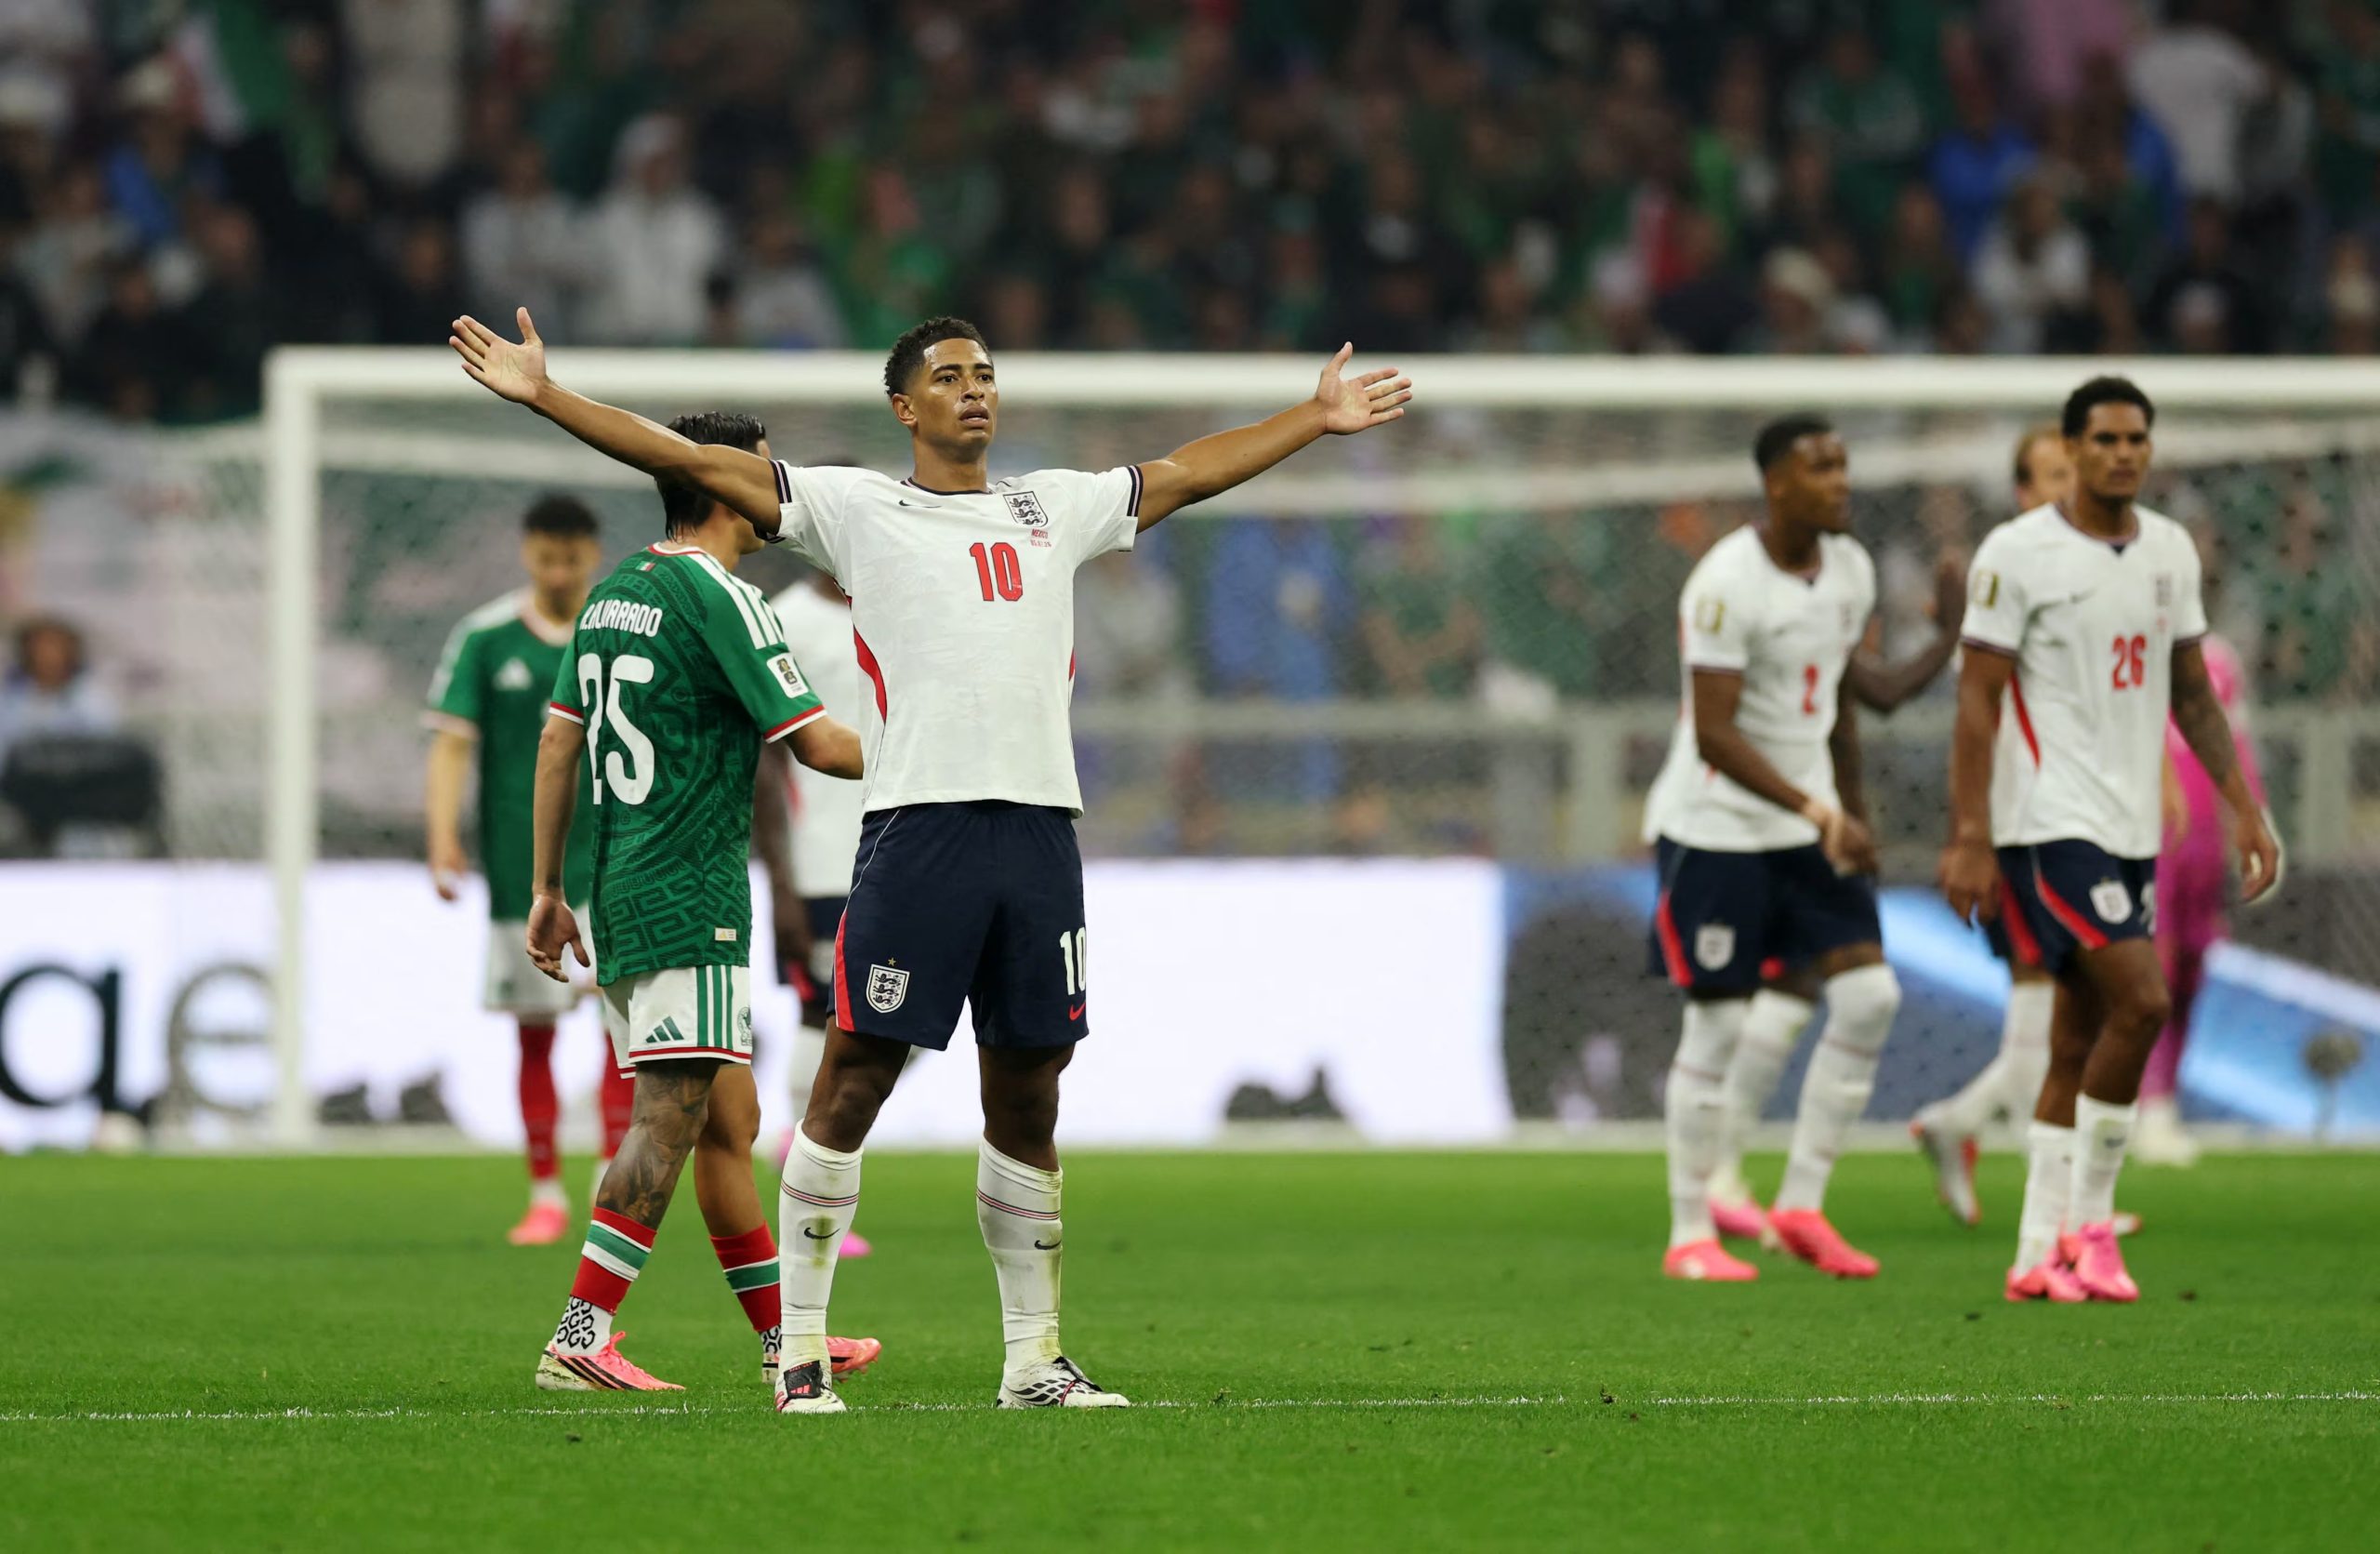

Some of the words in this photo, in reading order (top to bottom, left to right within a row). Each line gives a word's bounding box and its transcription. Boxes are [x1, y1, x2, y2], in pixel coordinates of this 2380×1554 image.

[1031, 528, 1048, 539] MEXICO
[969, 542, 1023, 602] 10
[1802, 663, 1819, 715] 2
[2110, 633, 2146, 690] 26
[577, 653, 654, 805] 25
[1060, 926, 1086, 995] 10
